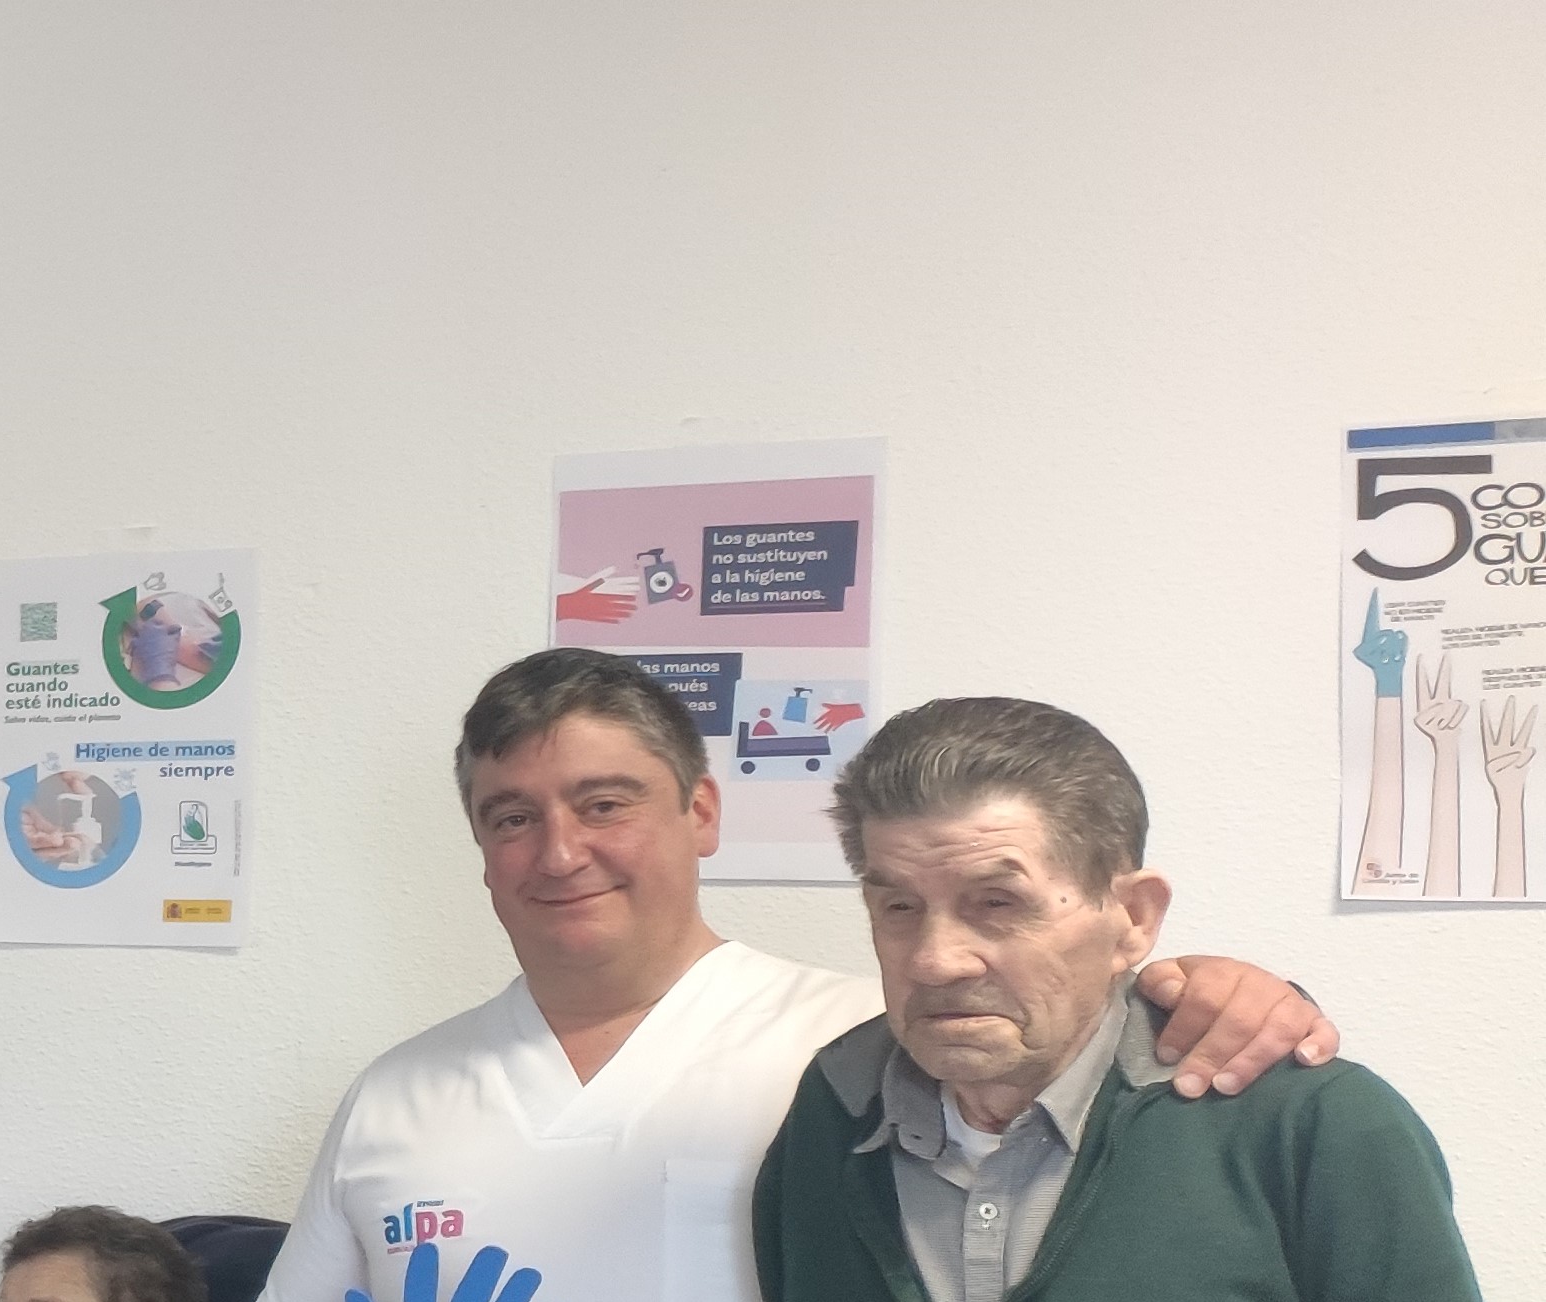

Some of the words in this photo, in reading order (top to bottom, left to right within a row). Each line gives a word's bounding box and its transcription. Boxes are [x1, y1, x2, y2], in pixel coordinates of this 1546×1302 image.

[1353, 454, 1492, 581] 5
[713, 532, 742, 546] Los
[745, 530, 816, 548] guantes
[712, 554, 734, 565] no
[737, 548, 828, 565] sustituyen
[1473, 532, 1546, 565] GU
[711, 574, 722, 584] a
[725, 569, 741, 583] la
[744, 568, 806, 586] higiene
[1485, 567, 1546, 586] QUE
[710, 590, 732, 604] de
[735, 588, 760, 603] las
[763, 589, 827, 602] manos.
[6, 661, 80, 676] Guantes
[664, 662, 721, 674] manos
[5, 677, 69, 693] cuando
[5, 694, 42, 710] esté
[47, 692, 121, 709] indicado
[75, 743, 143, 762] Higiene
[148, 743, 170, 758] de
[175, 744, 236, 757] manos
[159, 763, 235, 781] siempre
[383, 1202, 464, 1246] alpa
